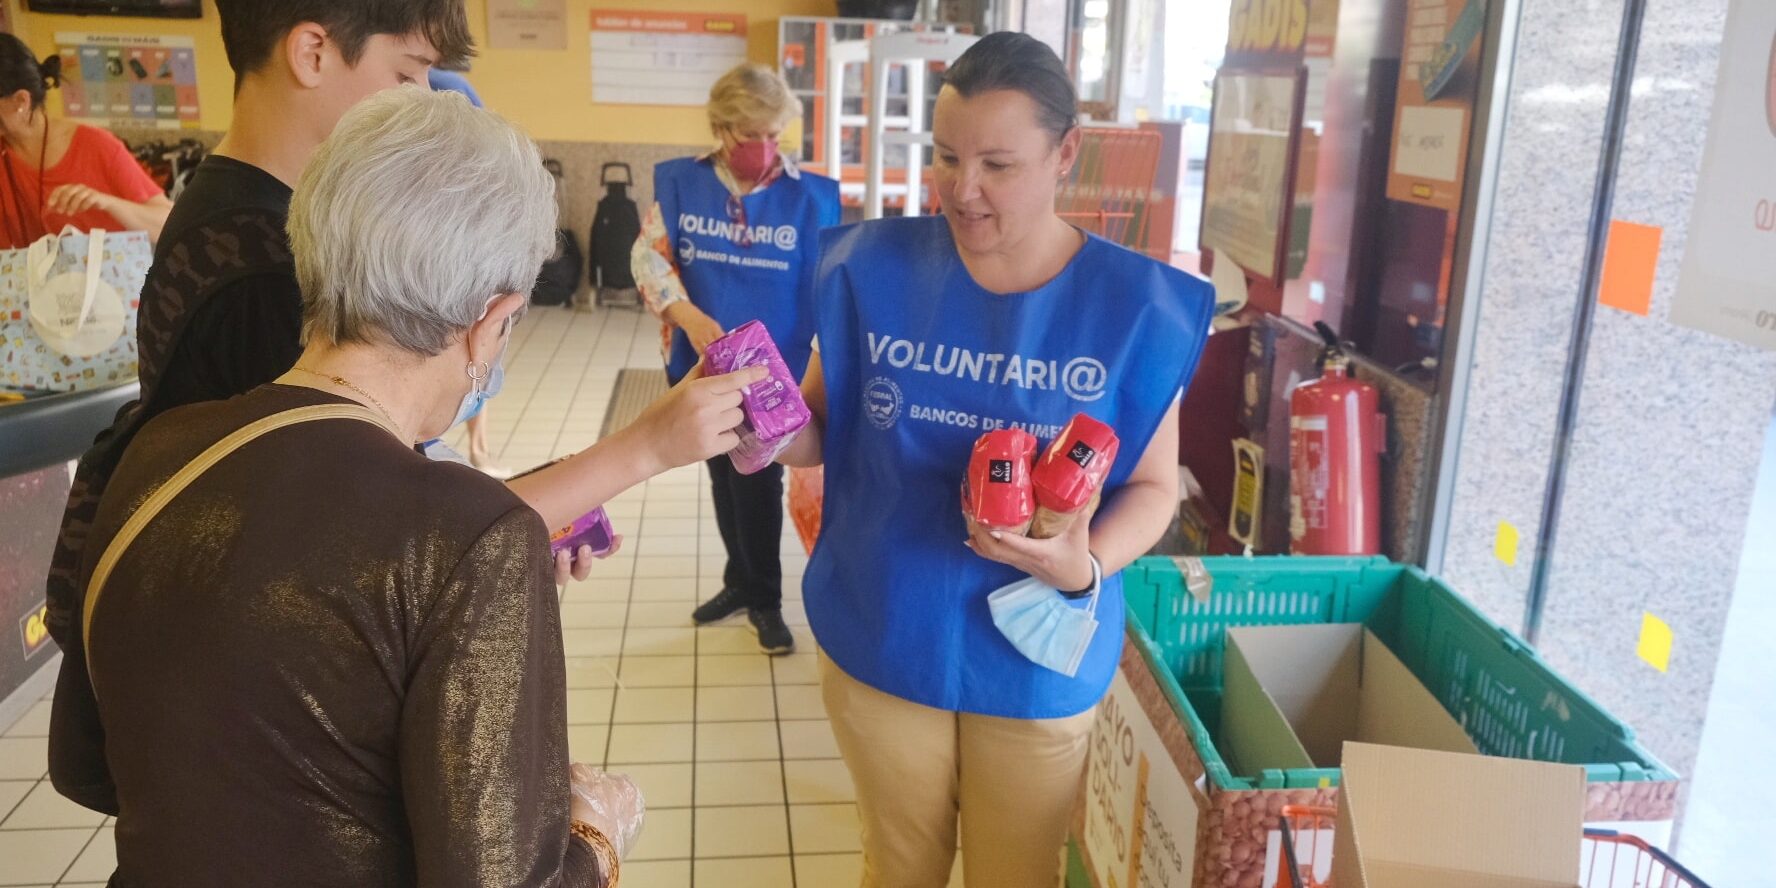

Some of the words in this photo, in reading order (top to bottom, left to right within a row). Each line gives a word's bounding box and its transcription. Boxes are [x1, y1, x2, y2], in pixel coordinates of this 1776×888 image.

[696, 249, 728, 262] BANCO
[728, 254, 740, 265] DE
[741, 256, 789, 271] ALIMENTOS
[867, 332, 1107, 401] VOLUNTARI@
[909, 404, 978, 429] BANCOS
[982, 417, 1004, 431] DE
[1009, 421, 1063, 439] ALIME
[1080, 450, 1094, 467] GALLO
[1104, 693, 1134, 767] AYO
